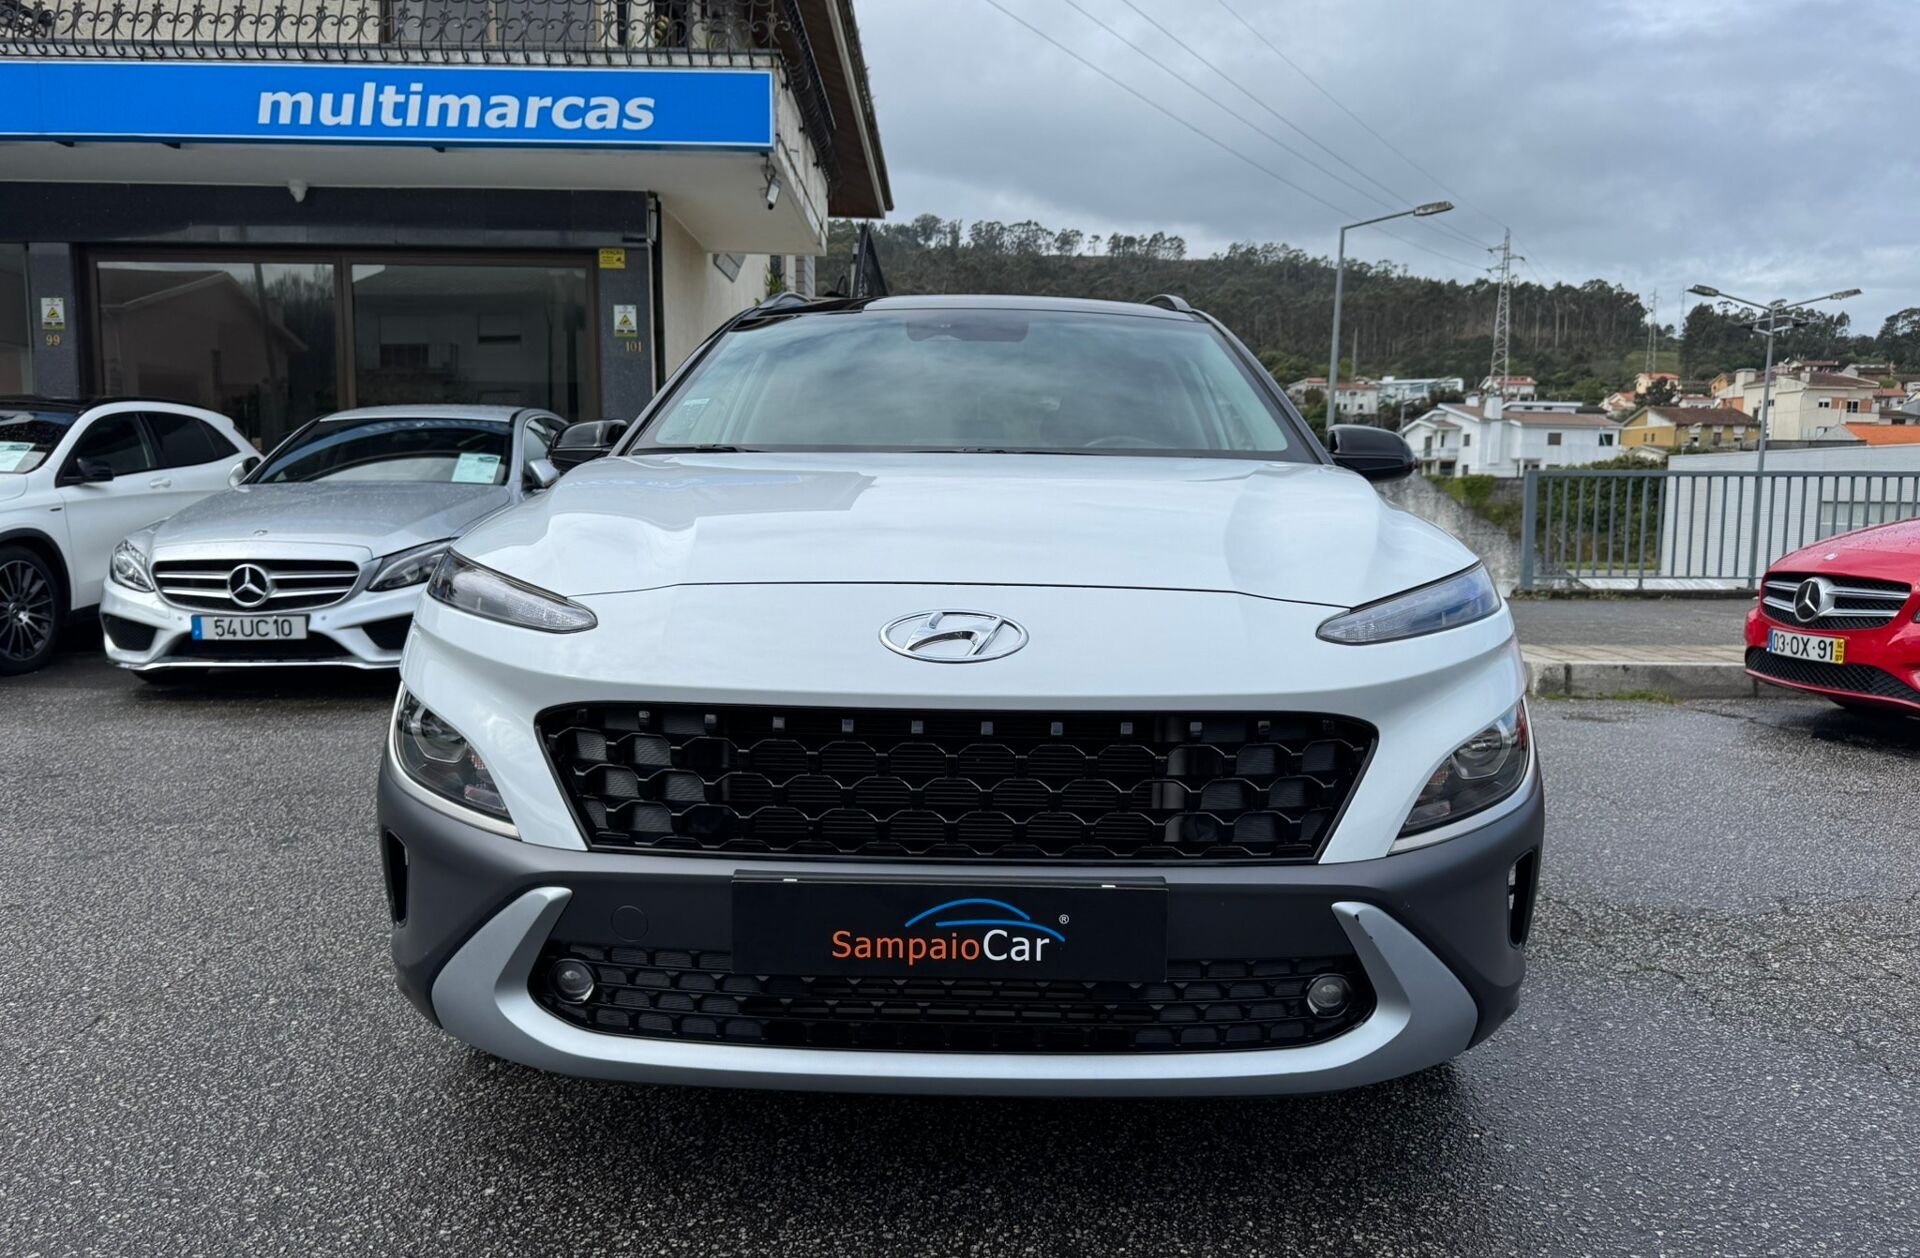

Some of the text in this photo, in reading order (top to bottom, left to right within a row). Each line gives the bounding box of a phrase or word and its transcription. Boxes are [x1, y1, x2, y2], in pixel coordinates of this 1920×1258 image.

[257, 81, 655, 131] multimarcas
[46, 335, 60, 346] 99
[624, 341, 642, 353] 101
[831, 929, 1050, 966] SampaioCar
